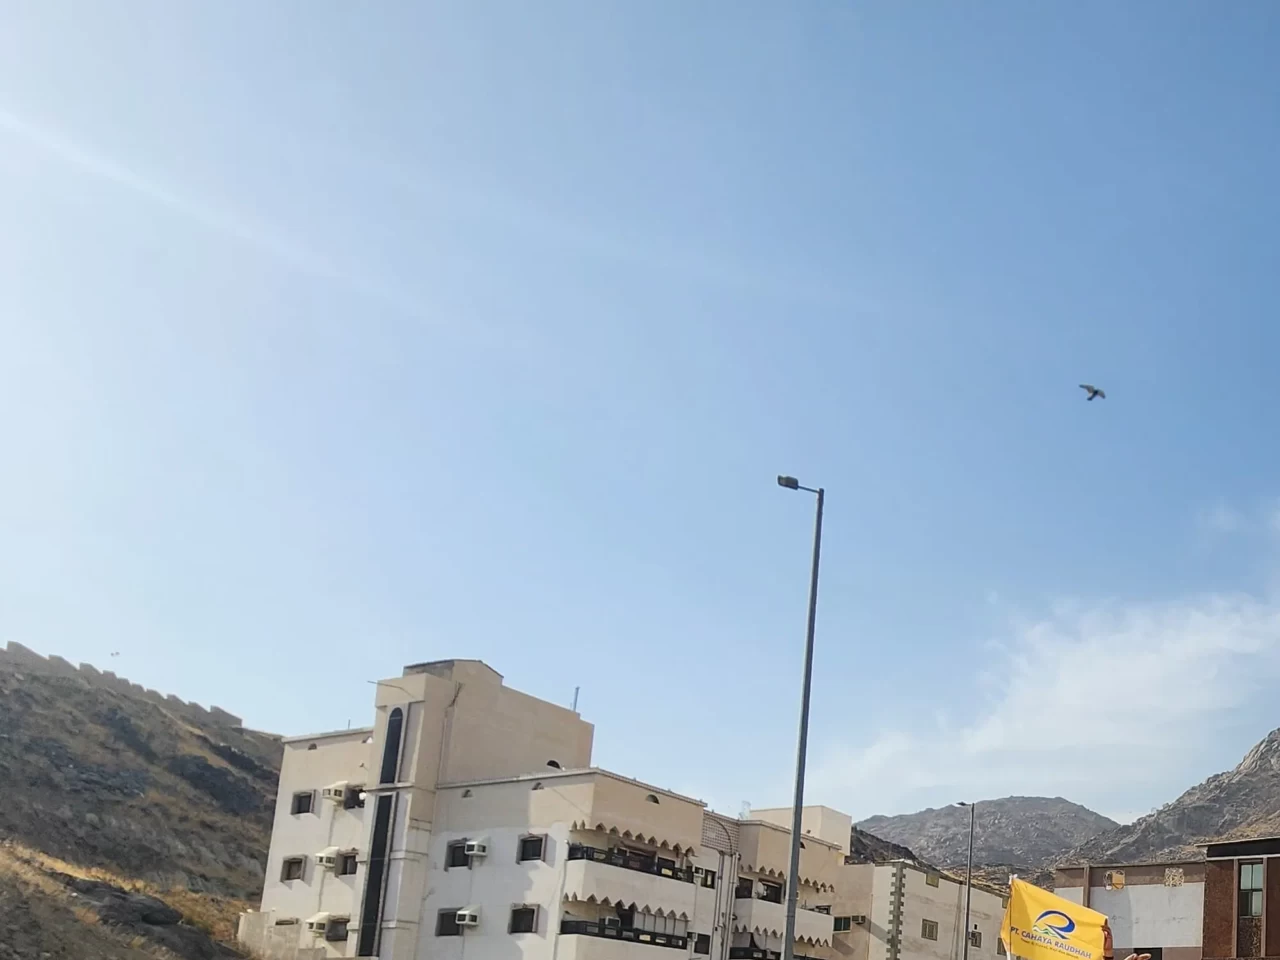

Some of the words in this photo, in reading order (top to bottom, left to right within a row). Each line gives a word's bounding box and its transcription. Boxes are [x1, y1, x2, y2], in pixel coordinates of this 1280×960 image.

[1010, 926, 1020, 936] PT.
[1021, 930, 1052, 945] CAHAYA
[1054, 941, 1092, 959] RAUDHAH
